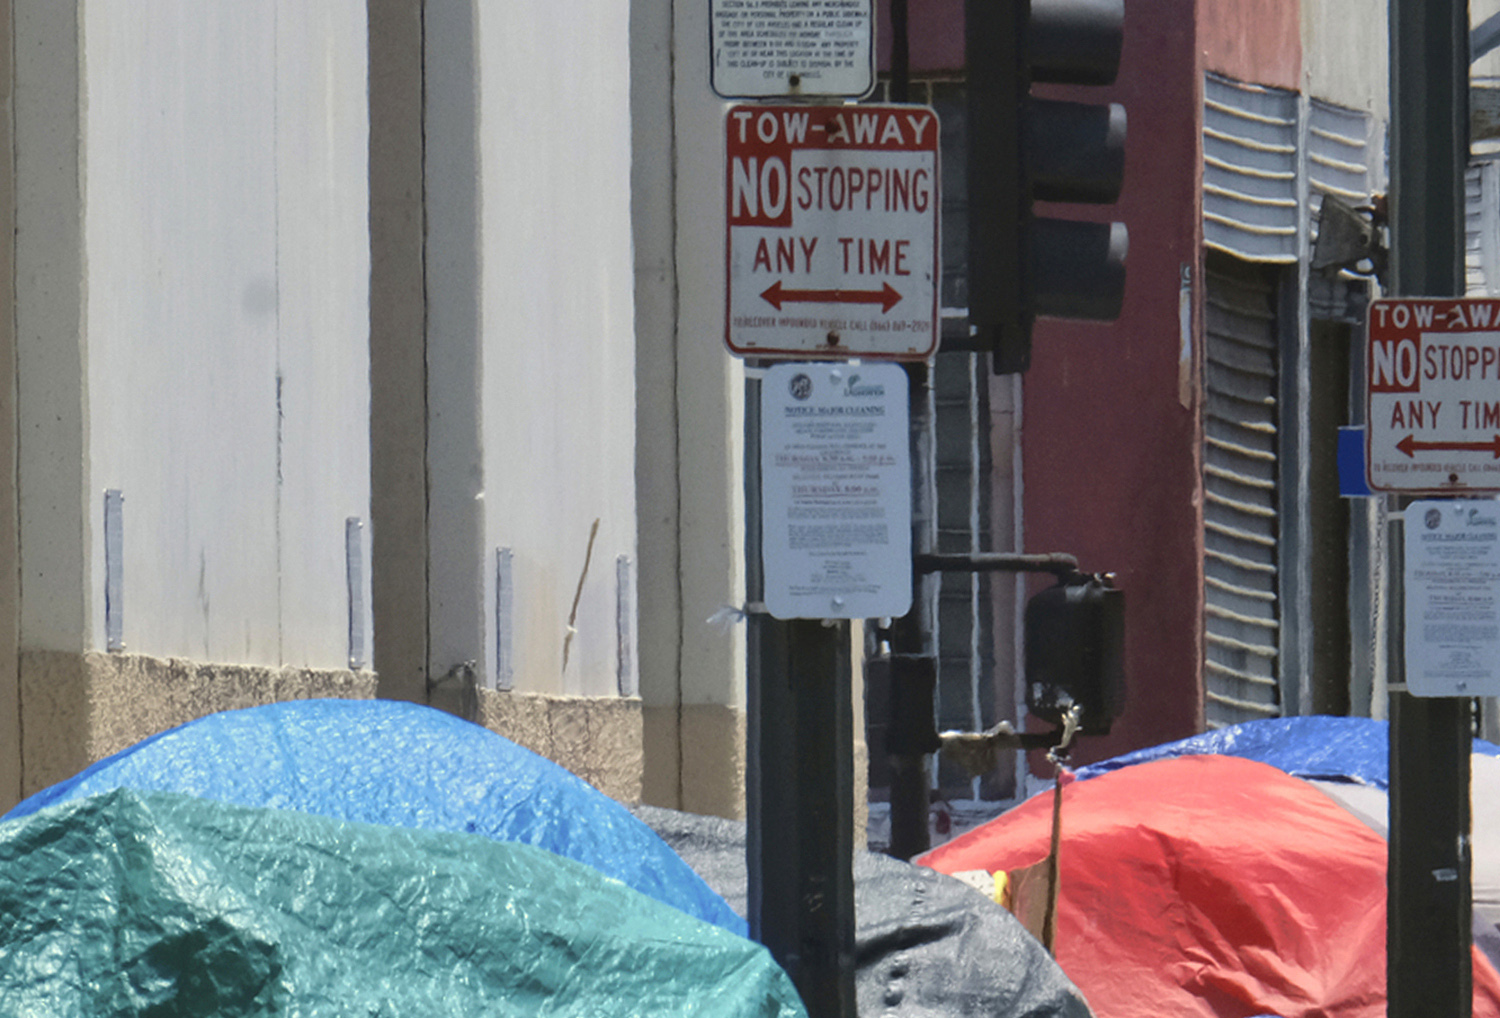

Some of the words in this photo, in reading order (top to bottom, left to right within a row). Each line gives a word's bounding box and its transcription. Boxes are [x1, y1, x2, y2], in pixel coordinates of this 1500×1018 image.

[733, 111, 930, 145] TOW-AWAY
[732, 155, 787, 219] NO
[797, 166, 929, 213] STOPPING
[752, 236, 818, 274] ANY
[837, 237, 911, 276] TIME
[1372, 338, 1417, 387] NO
[1390, 400, 1442, 429] ANY
